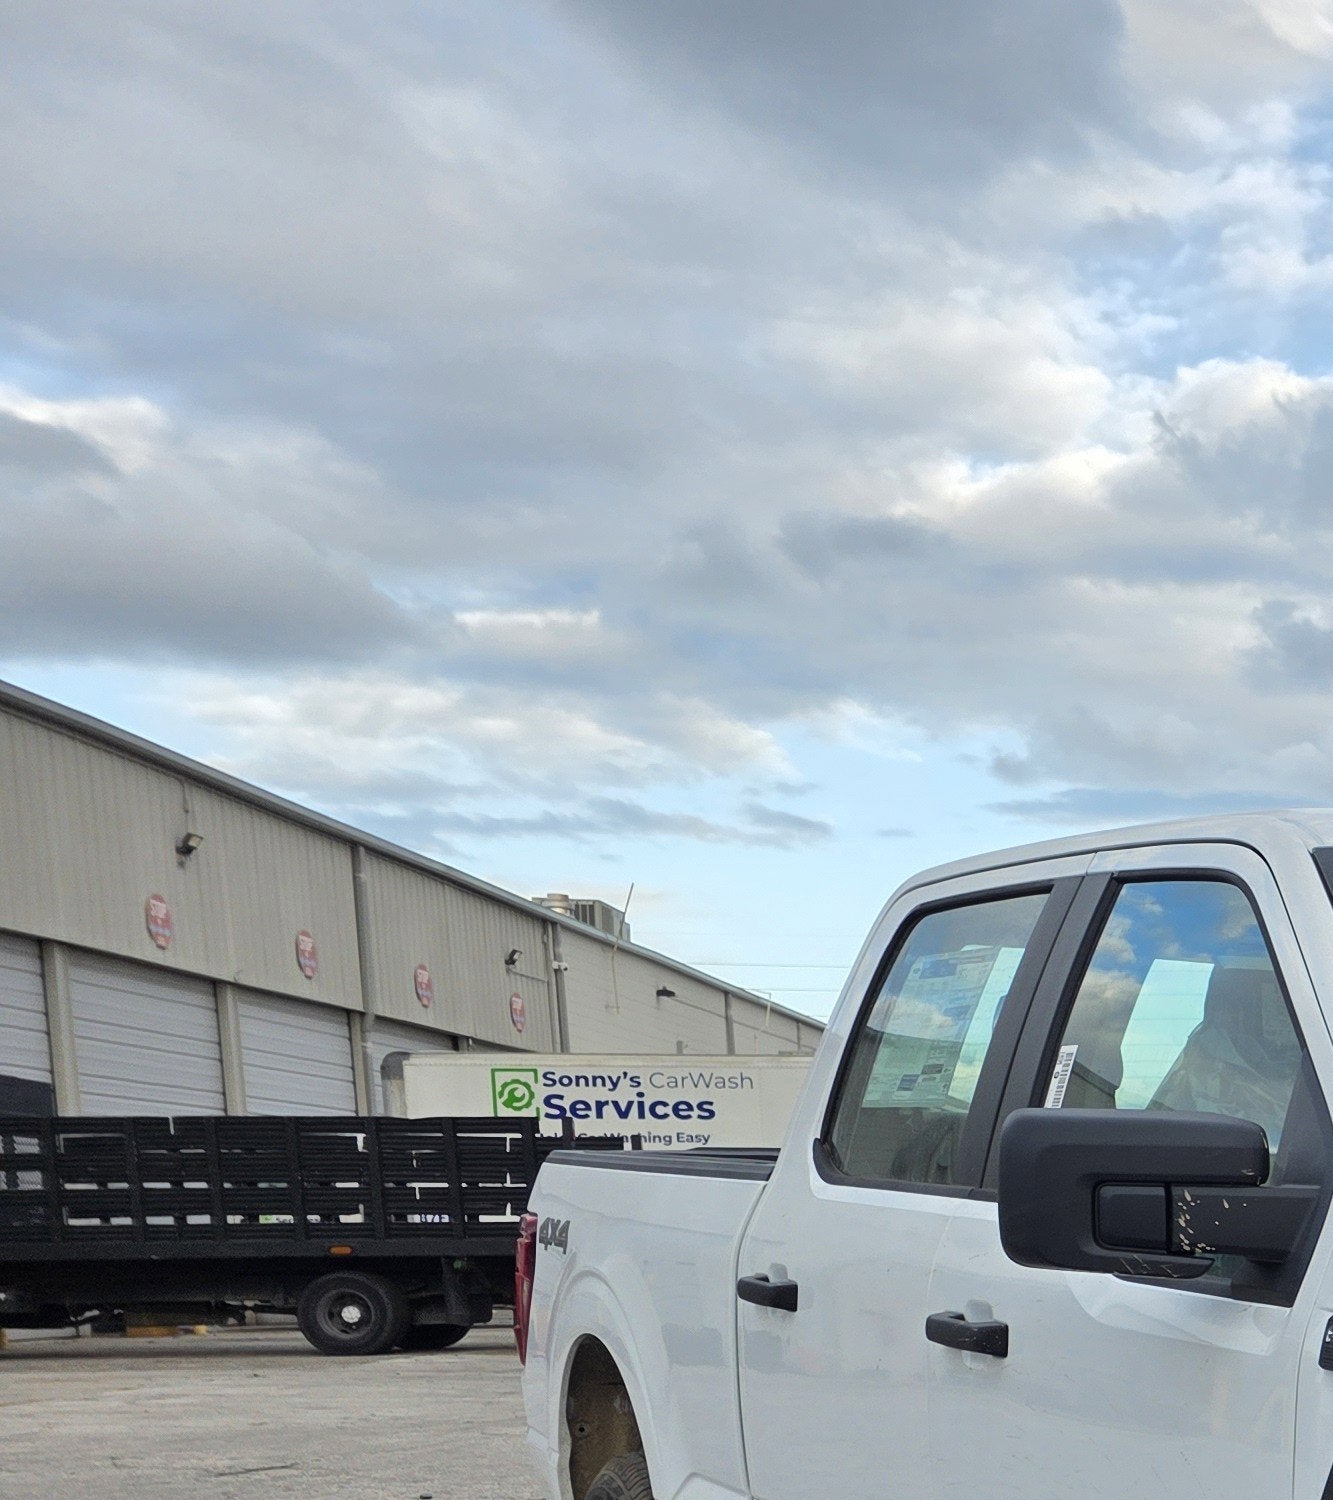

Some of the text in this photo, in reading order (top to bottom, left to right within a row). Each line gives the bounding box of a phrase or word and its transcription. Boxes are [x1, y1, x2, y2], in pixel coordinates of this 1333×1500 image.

[542, 1071, 754, 1092] Sonny's CarWash
[543, 1091, 716, 1121] Services
[676, 1132, 711, 1145] Easy
